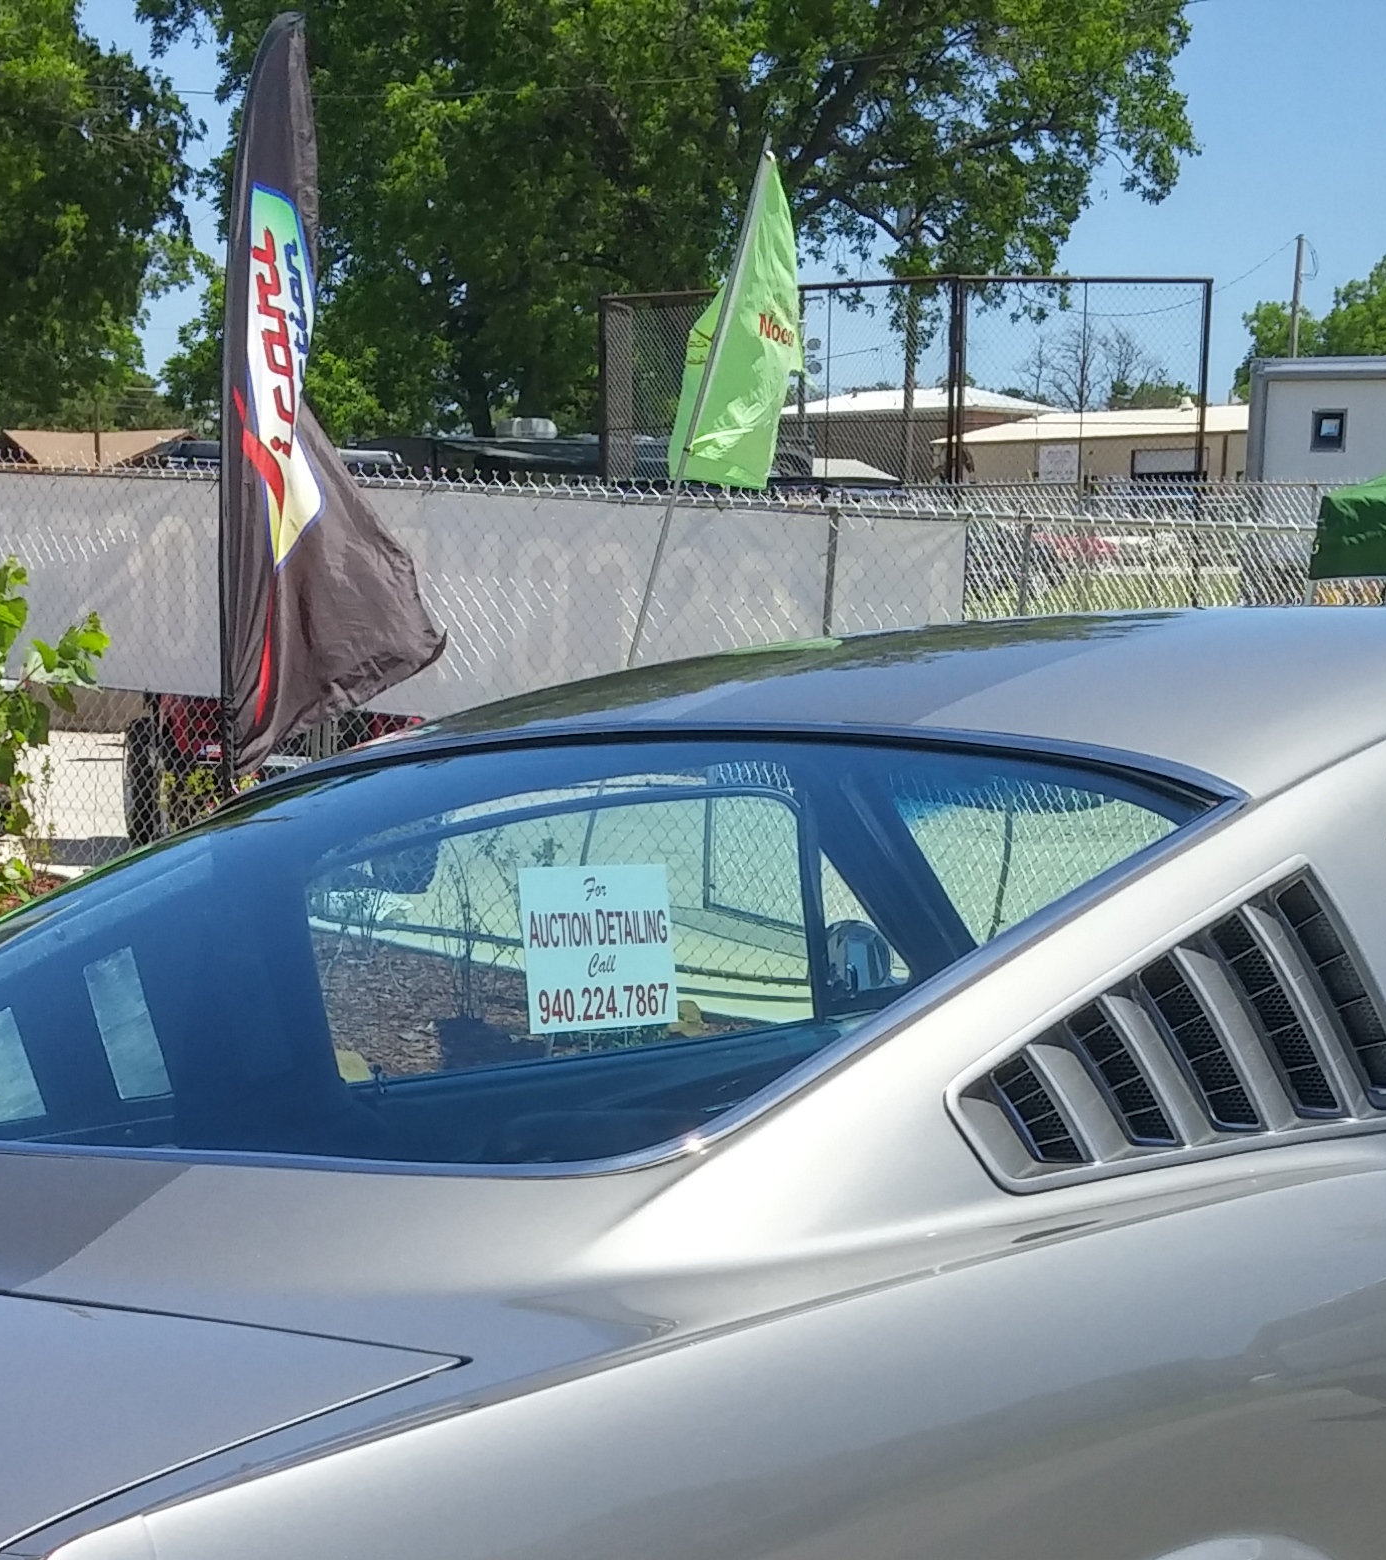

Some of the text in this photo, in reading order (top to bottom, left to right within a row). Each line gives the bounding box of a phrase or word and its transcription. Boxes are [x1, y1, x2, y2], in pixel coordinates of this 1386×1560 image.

[583, 877, 607, 901] For
[529, 909, 668, 948] AUCTION DETAILING
[587, 952, 616, 978] Call
[539, 982, 669, 1025] 940.224.7867
